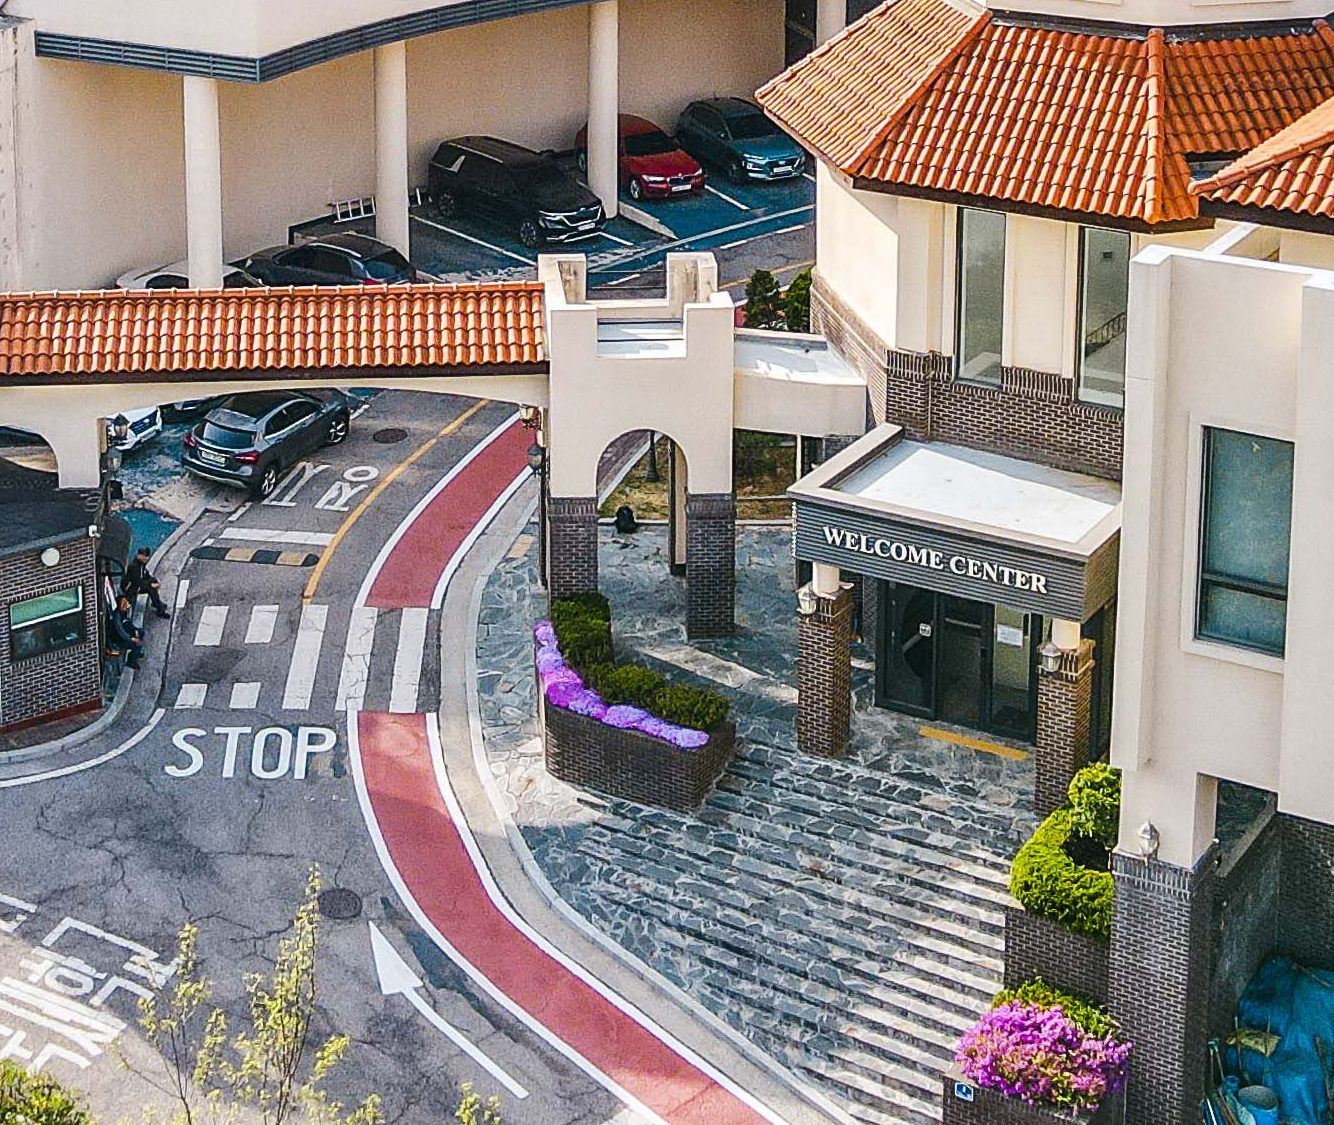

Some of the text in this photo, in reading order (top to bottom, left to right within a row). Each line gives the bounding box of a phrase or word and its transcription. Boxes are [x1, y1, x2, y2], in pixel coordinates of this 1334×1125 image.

[822, 526, 1048, 594] WELCOME CENTER
[164, 725, 338, 780] STOP
